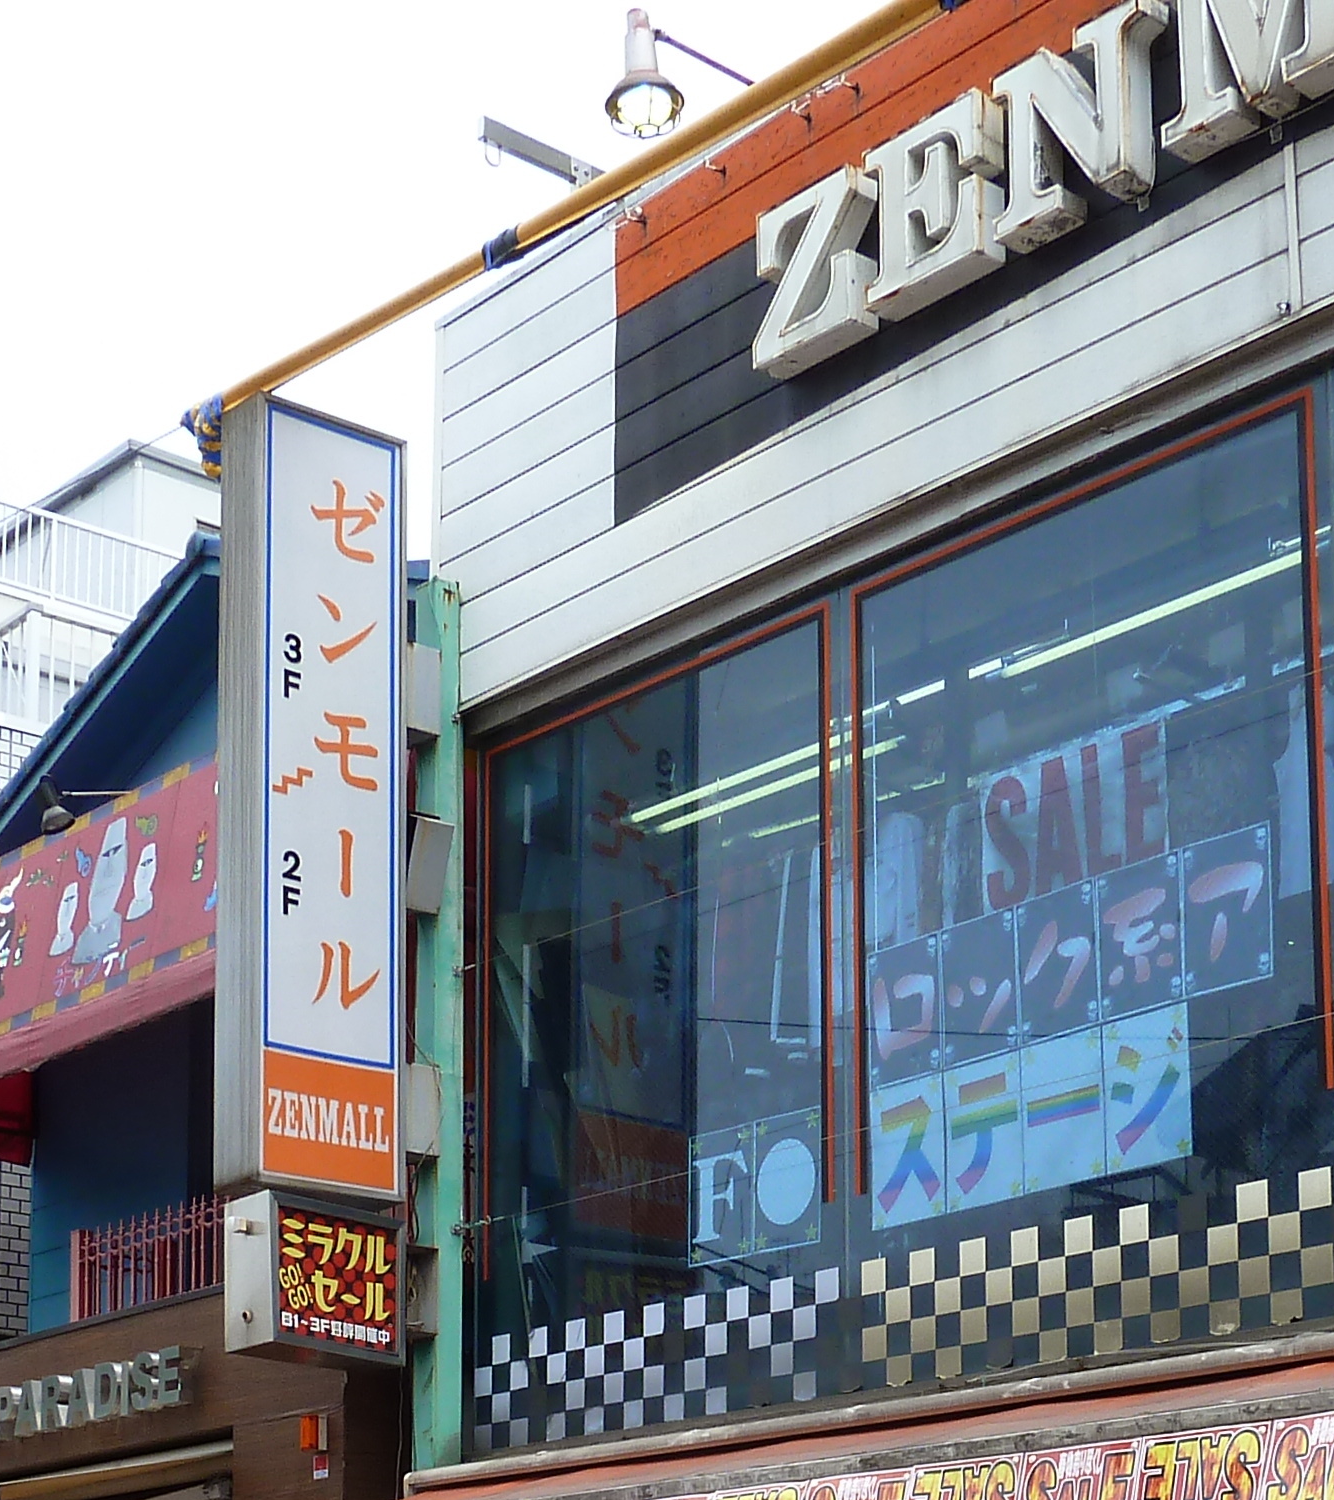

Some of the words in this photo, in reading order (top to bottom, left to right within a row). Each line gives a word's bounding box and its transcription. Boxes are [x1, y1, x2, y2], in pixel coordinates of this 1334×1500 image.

[311, 479, 385, 1010] ゼンモール
[984, 721, 1165, 909] SALE
[268, 1087, 390, 1153] ZENMALL
[282, 1218, 392, 1275] ミラクル
[279, 1262, 304, 1289] GO!
[288, 1283, 314, 1310] GO!
[311, 1269, 390, 1321] セール
